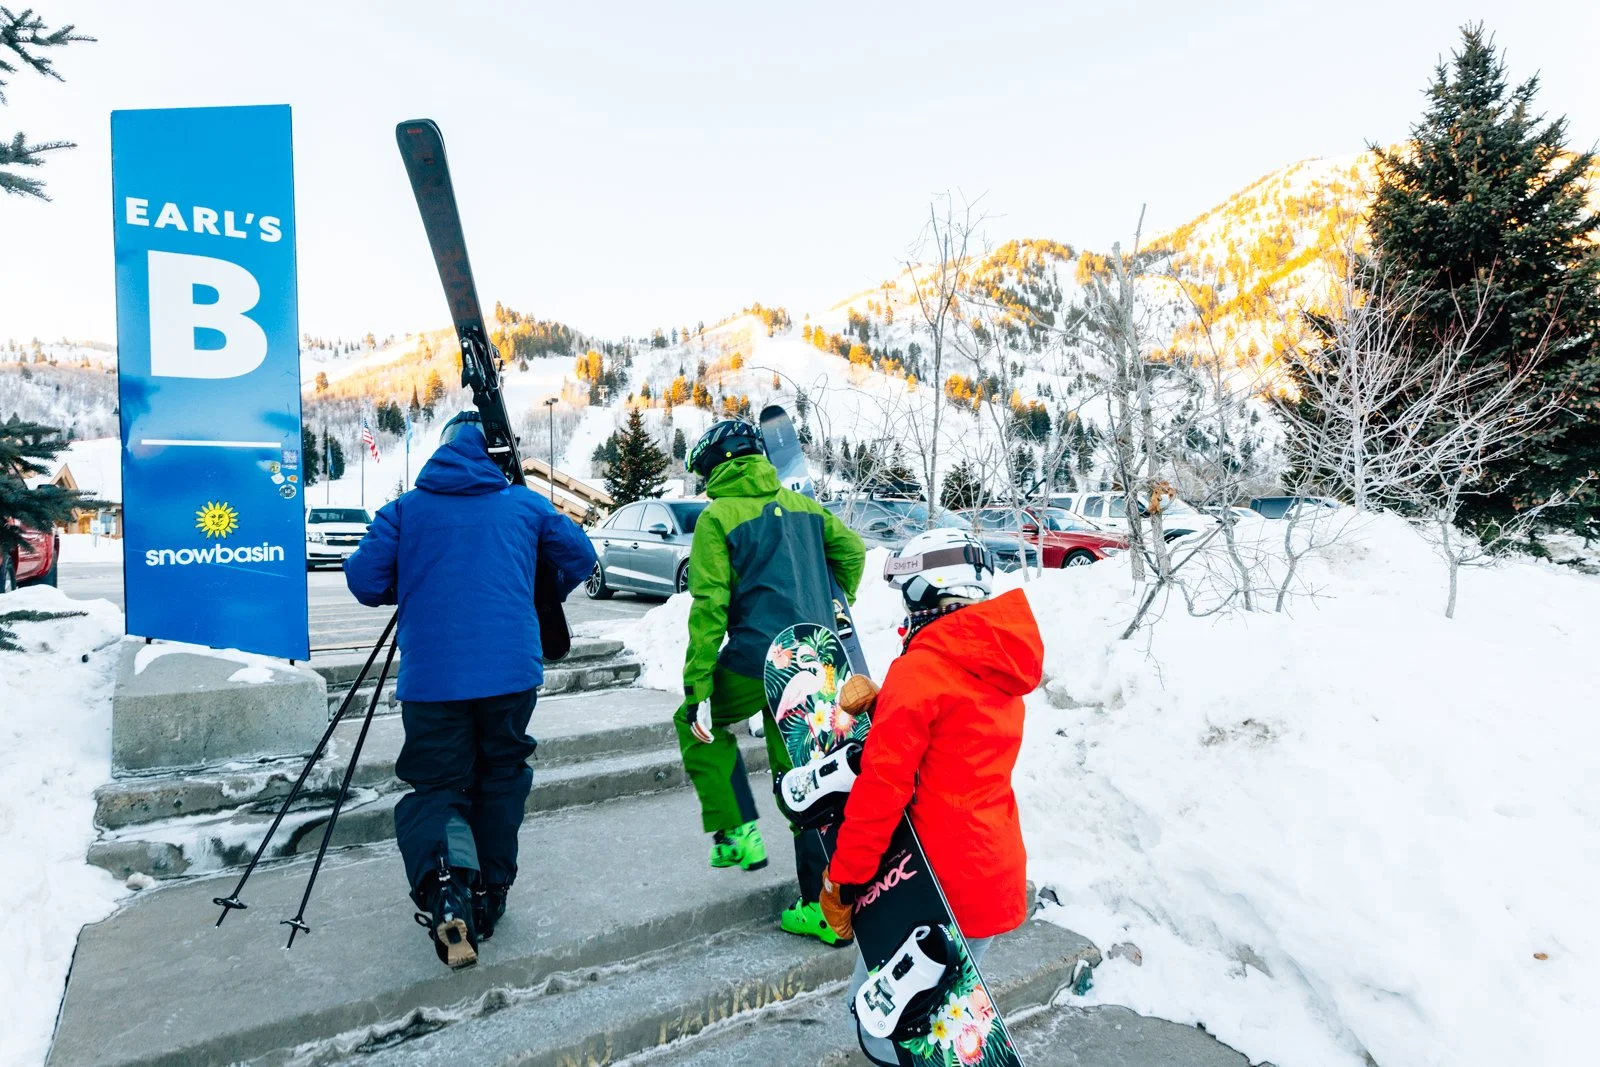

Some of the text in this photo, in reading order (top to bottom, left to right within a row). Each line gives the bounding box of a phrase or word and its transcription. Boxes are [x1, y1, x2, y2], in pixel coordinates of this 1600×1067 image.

[125, 197, 282, 243] EARL'S
[147, 250, 268, 380] B
[692, 438, 710, 459] SMITH
[145, 542, 285, 566] snowbasin
[893, 560, 919, 571] SMITH
